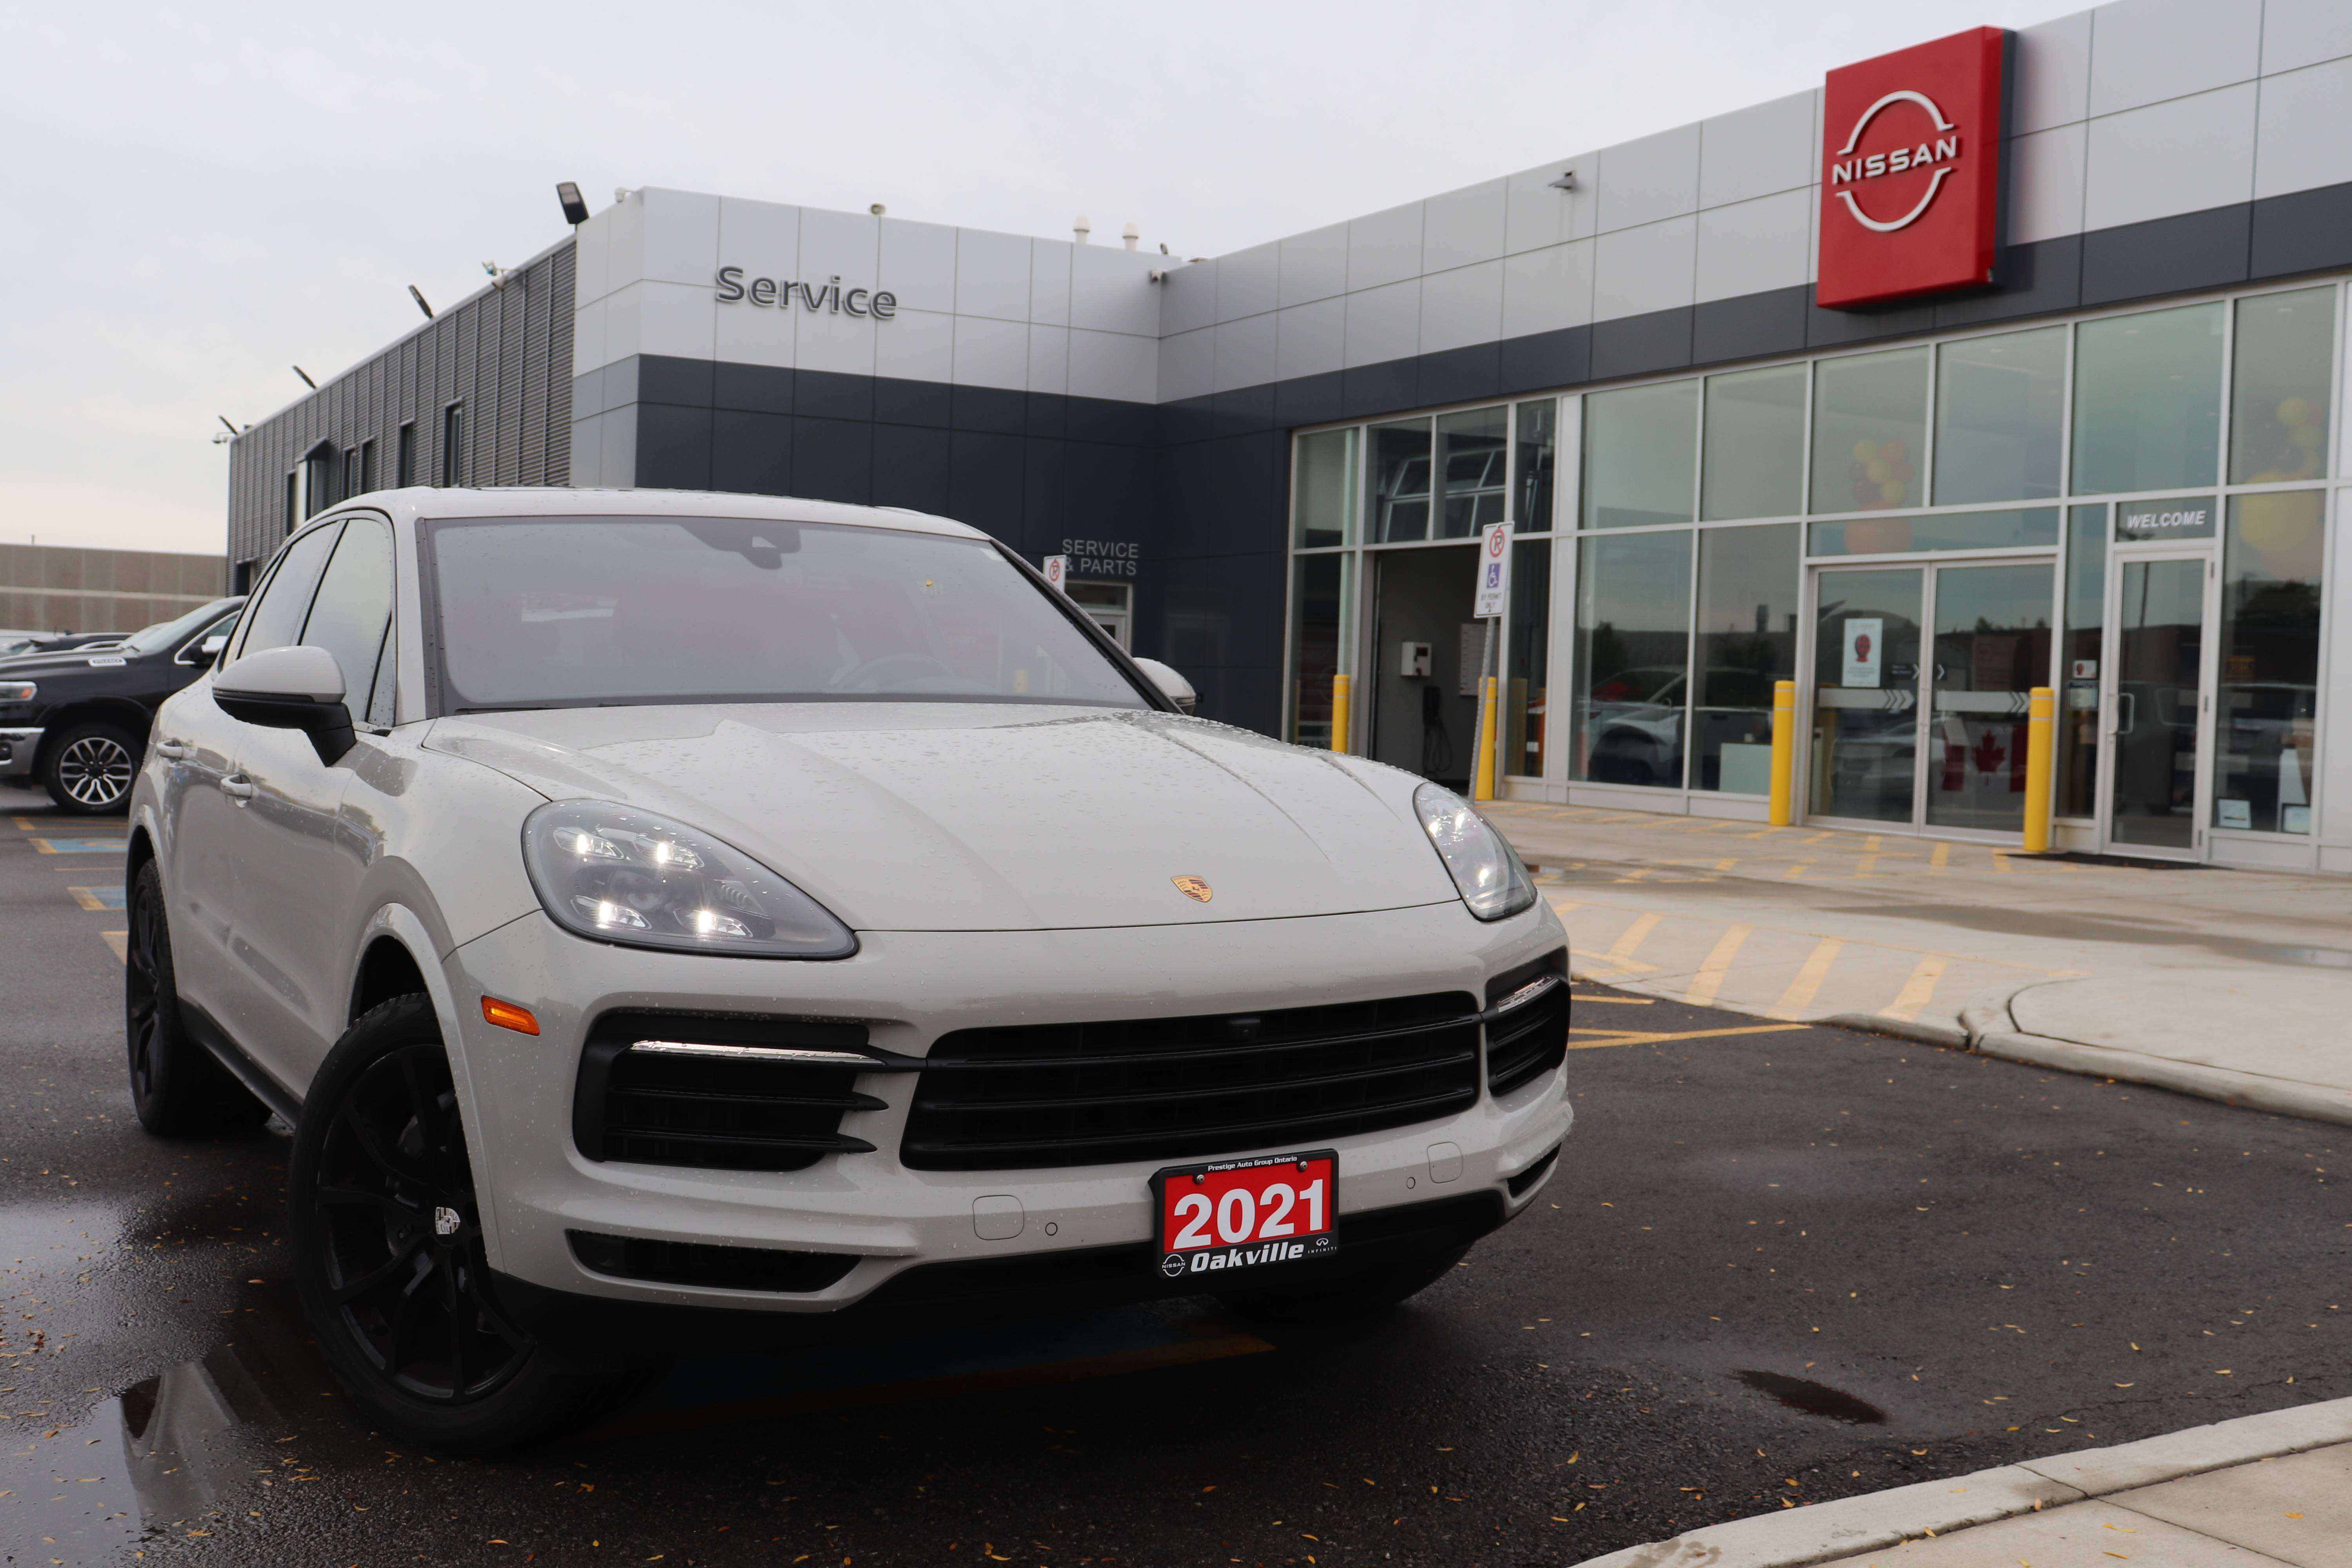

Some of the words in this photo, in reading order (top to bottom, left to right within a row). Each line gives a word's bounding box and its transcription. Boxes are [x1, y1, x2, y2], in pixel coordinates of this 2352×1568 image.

[1832, 136, 1957, 185] NISSAN
[716, 266, 897, 319] Service
[2127, 510, 2207, 528] WELCOME
[1062, 539, 1138, 558] SERVICE
[1065, 557, 1074, 572] &
[1080, 558, 1137, 575] PARTS
[1208, 1163, 1236, 1171] Prestige
[1173, 1178, 1323, 1250] 2021
[1161, 1261, 1186, 1269] NISSAN
[1190, 1241, 1305, 1273] Oakville
